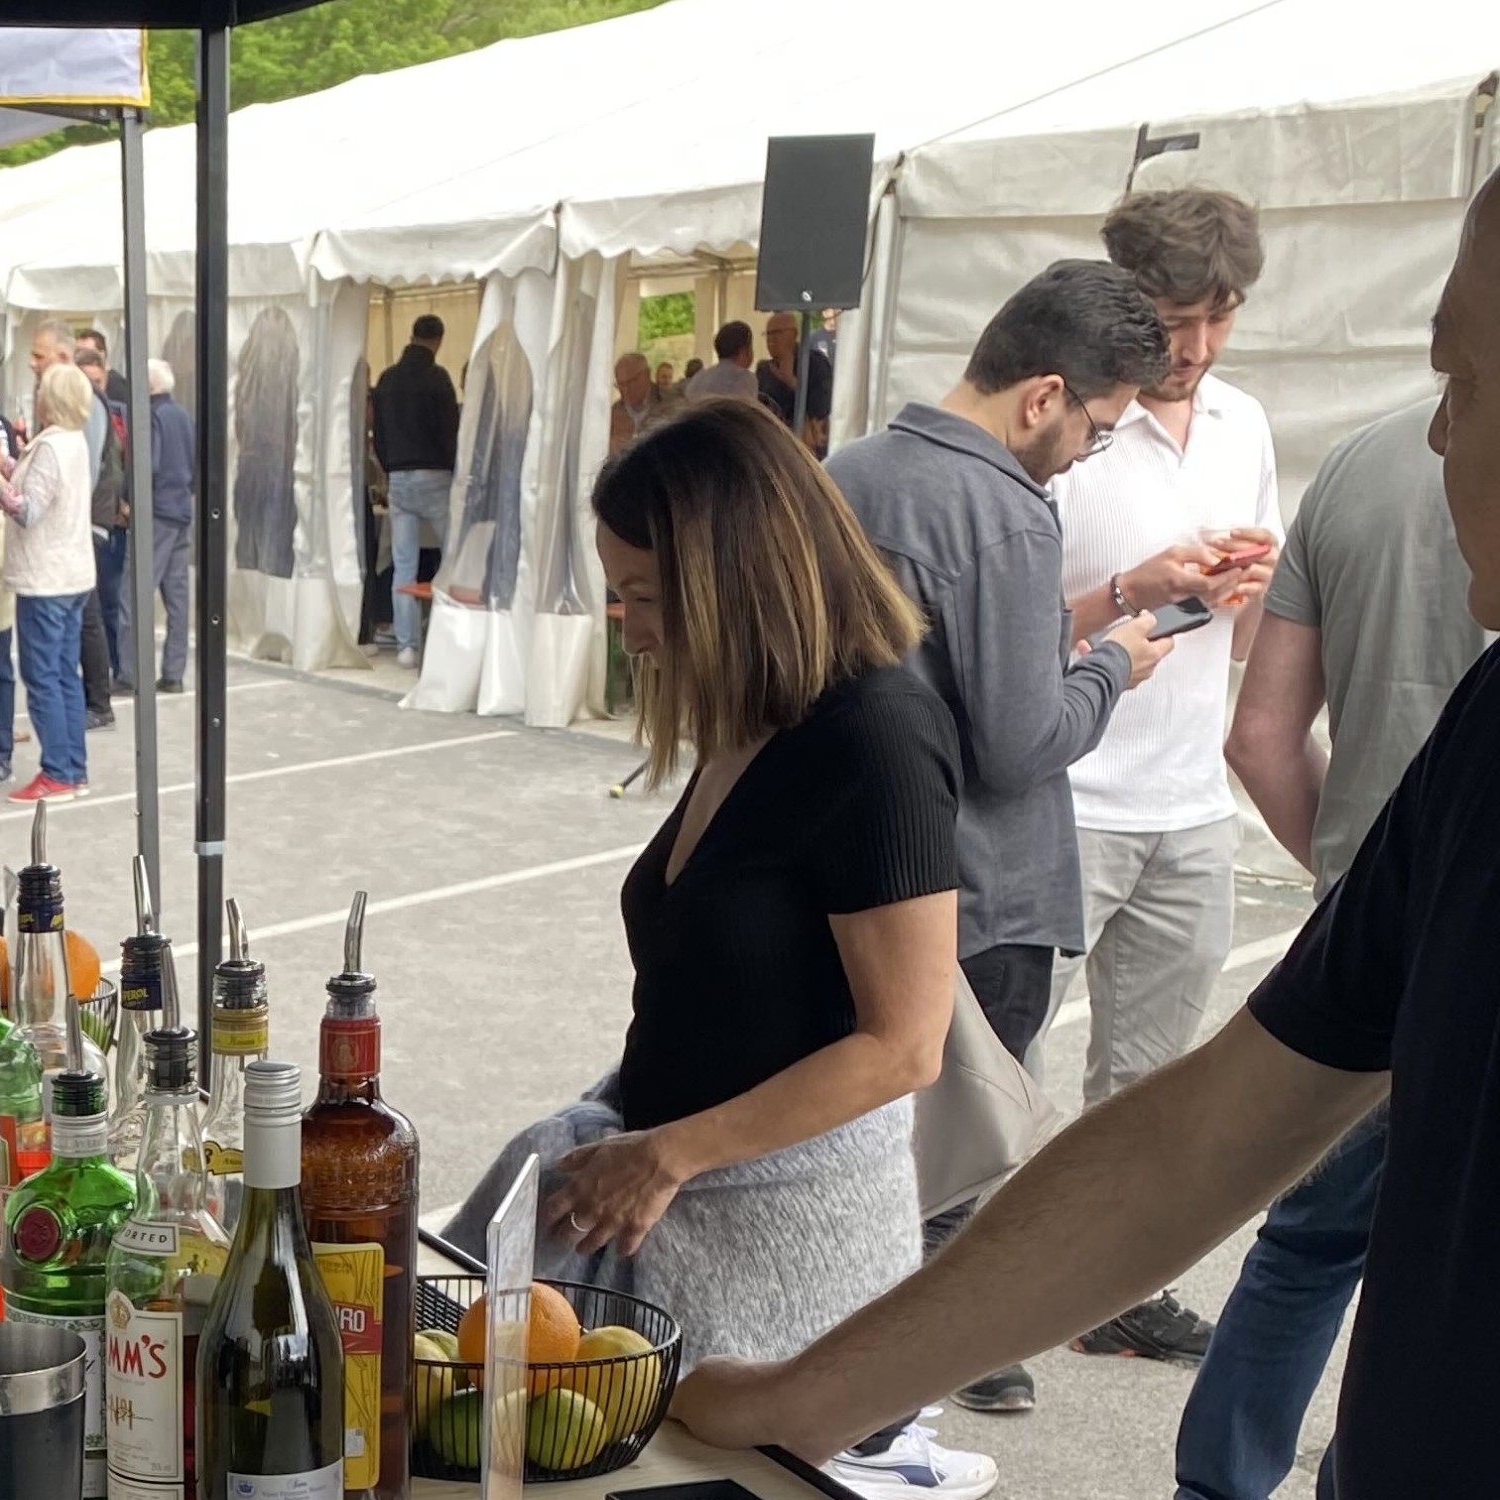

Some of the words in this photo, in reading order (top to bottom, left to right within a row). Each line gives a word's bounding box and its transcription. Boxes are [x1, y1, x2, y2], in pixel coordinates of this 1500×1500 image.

[121, 987, 149, 1001] PEROL
[122, 1228, 168, 1243] ORTED
[108, 1334, 167, 1379] MM'S
